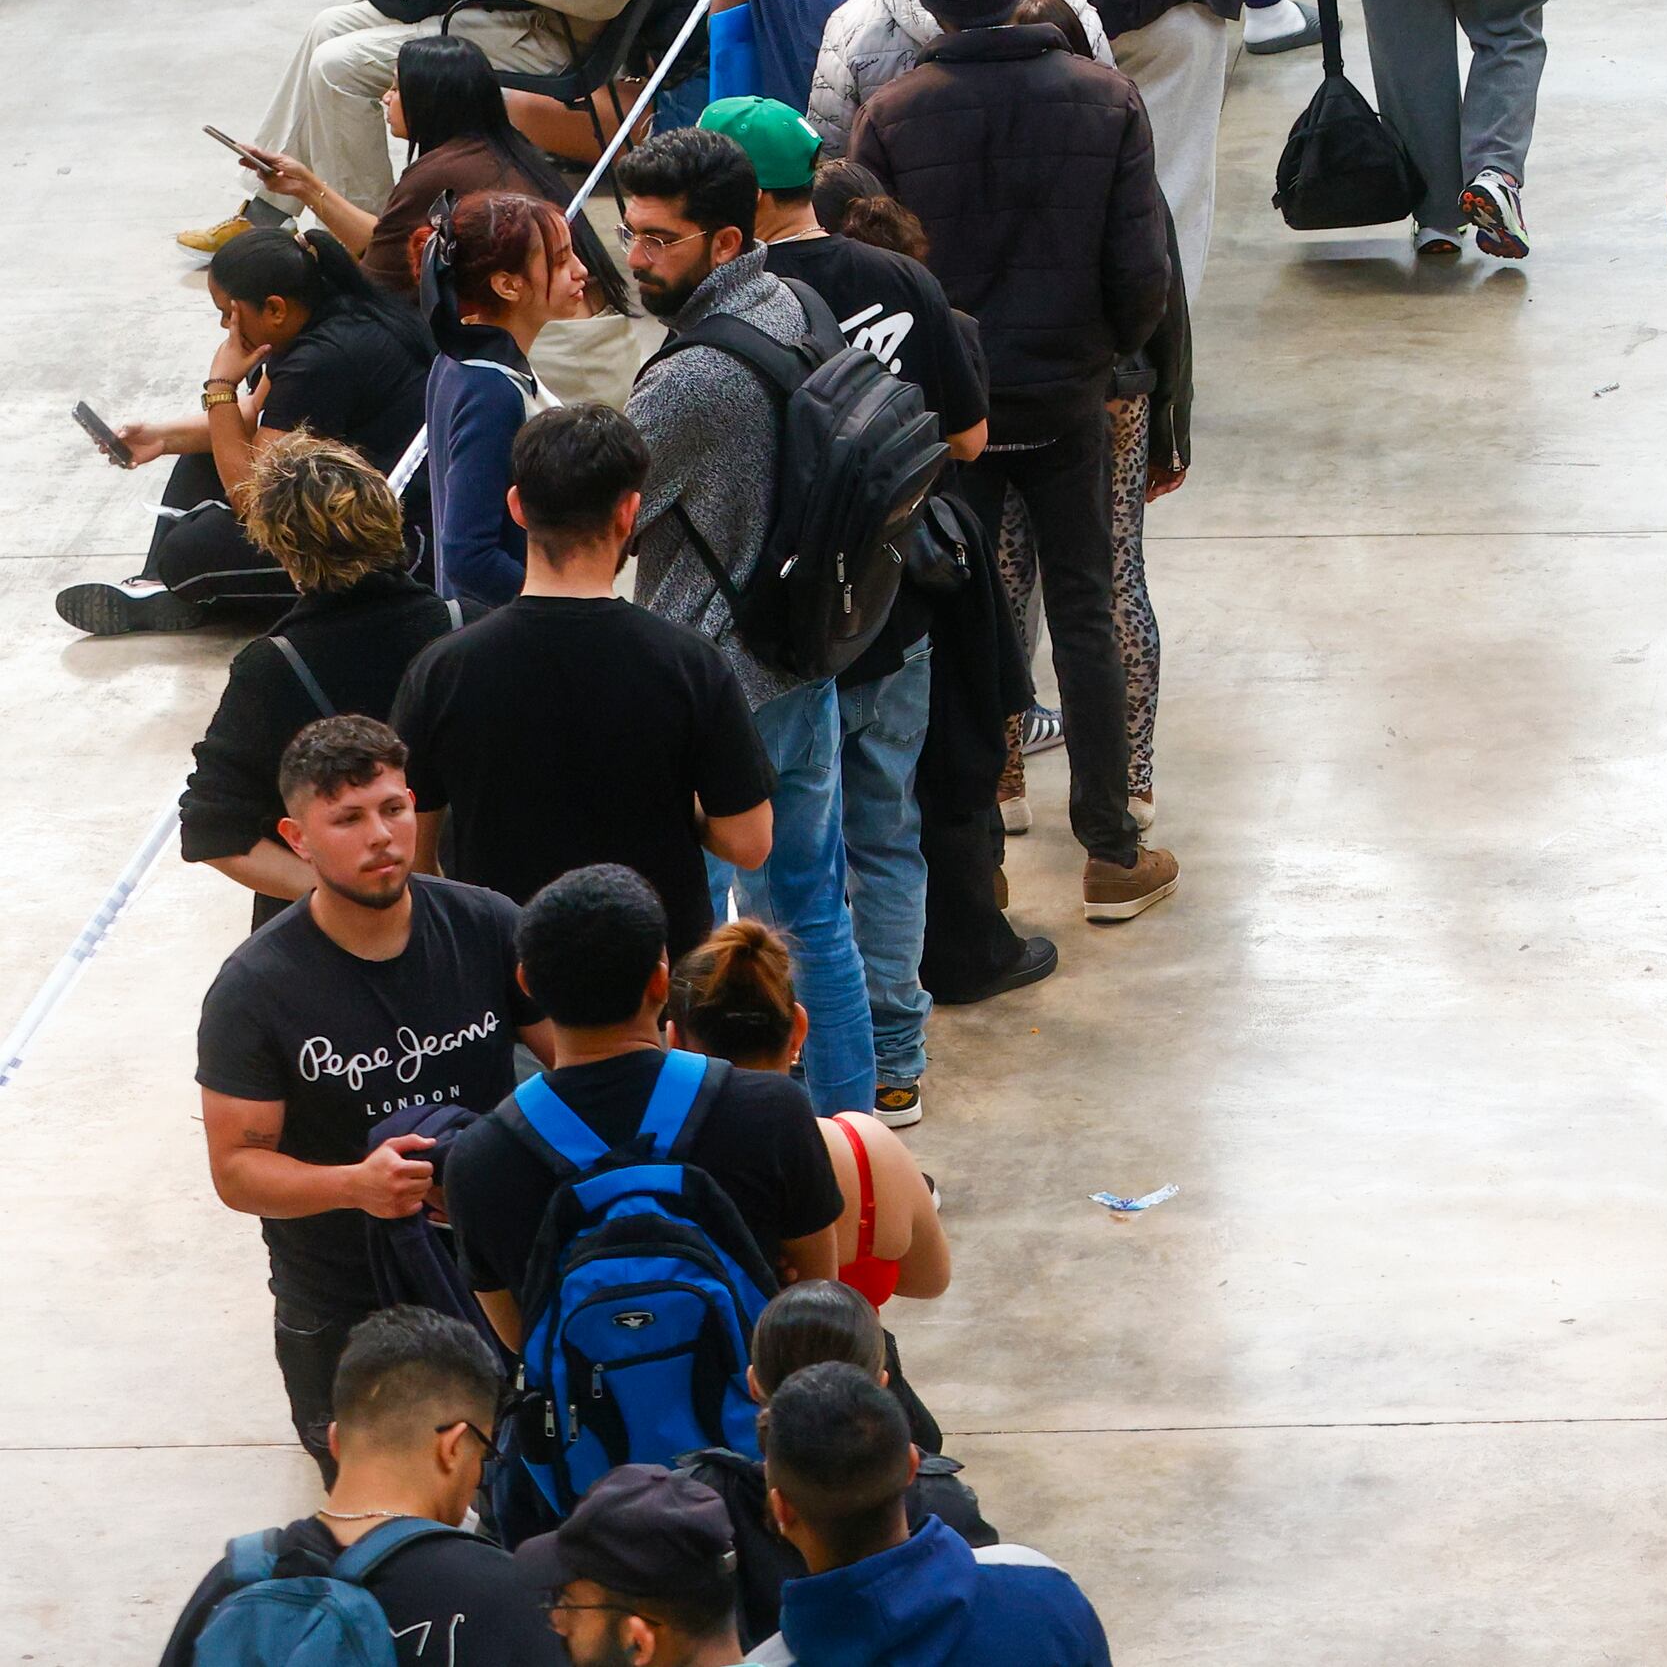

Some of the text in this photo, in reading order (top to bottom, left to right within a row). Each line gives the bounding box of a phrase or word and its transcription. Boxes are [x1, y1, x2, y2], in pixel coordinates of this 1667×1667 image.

[300, 1011, 499, 1091] Pepe Jeans
[366, 1085, 461, 1116] LONDON
